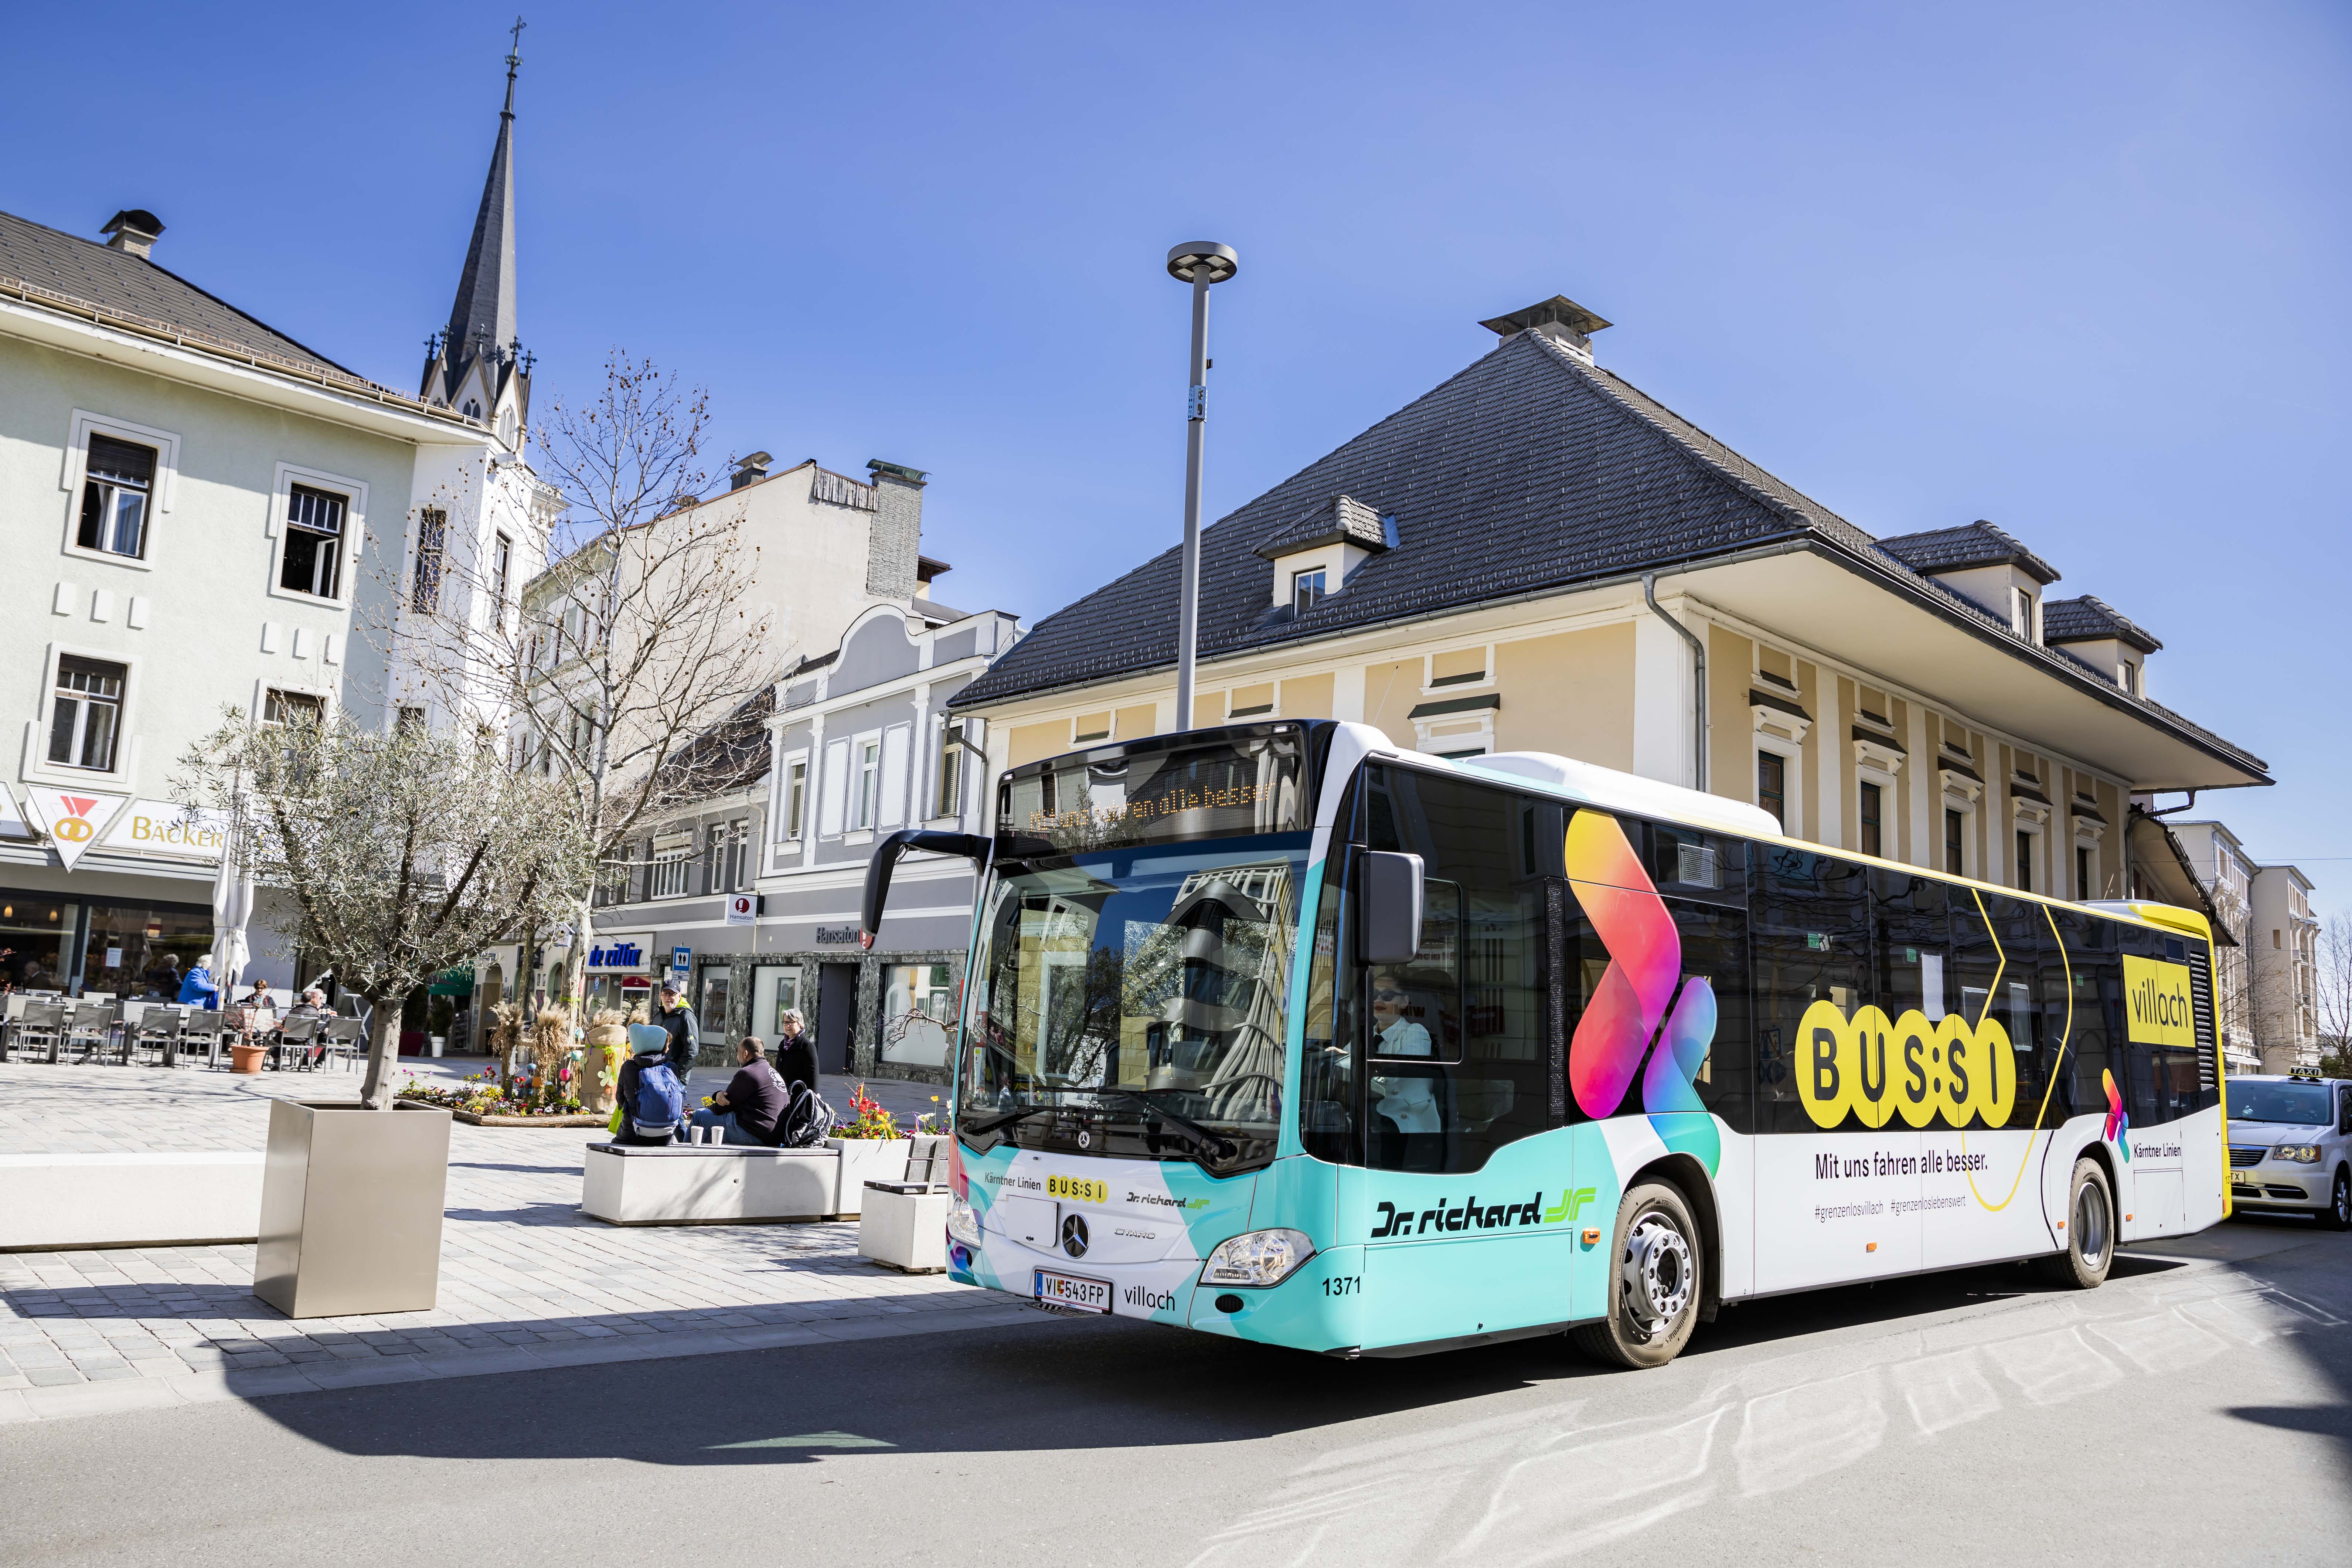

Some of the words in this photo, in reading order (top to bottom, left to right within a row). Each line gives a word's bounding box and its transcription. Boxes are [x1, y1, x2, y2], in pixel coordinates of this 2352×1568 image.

[1160, 789, 1198, 814] alle
[1204, 782, 1276, 808] besser
[816, 926, 860, 944] Hansaton
[589, 945, 604, 966] de
[2133, 978, 2188, 1028] villach
[2134, 1142, 2161, 1158] Kärntner
[2163, 1142, 2181, 1157] Linien
[1816, 1153, 1839, 1179] Mit
[1844, 1159, 1869, 1178] uns
[1873, 1151, 1916, 1176] fahren
[1921, 1150, 1942, 1173] alle
[1947, 1149, 1988, 1172] besser.
[984, 1172, 1015, 1187] Kärntner
[1017, 1177, 1041, 1191] Linien
[1126, 1192, 1140, 1203] Dr.
[1141, 1194, 1187, 1208] richard
[1815, 1200, 1883, 1223] #grenzenlosvillach
[1890, 1194, 1966, 1216] #grenzenloslebenswert
[1371, 1201, 1415, 1238] Dr.
[1417, 1191, 1542, 1234] richard
[1114, 1228, 1155, 1239] CITARO
[1046, 1277, 1056, 1296] VI
[1089, 1285, 1104, 1304] FP
[1322, 1276, 1361, 1296] 1371
[1124, 1285, 1175, 1311] villach
